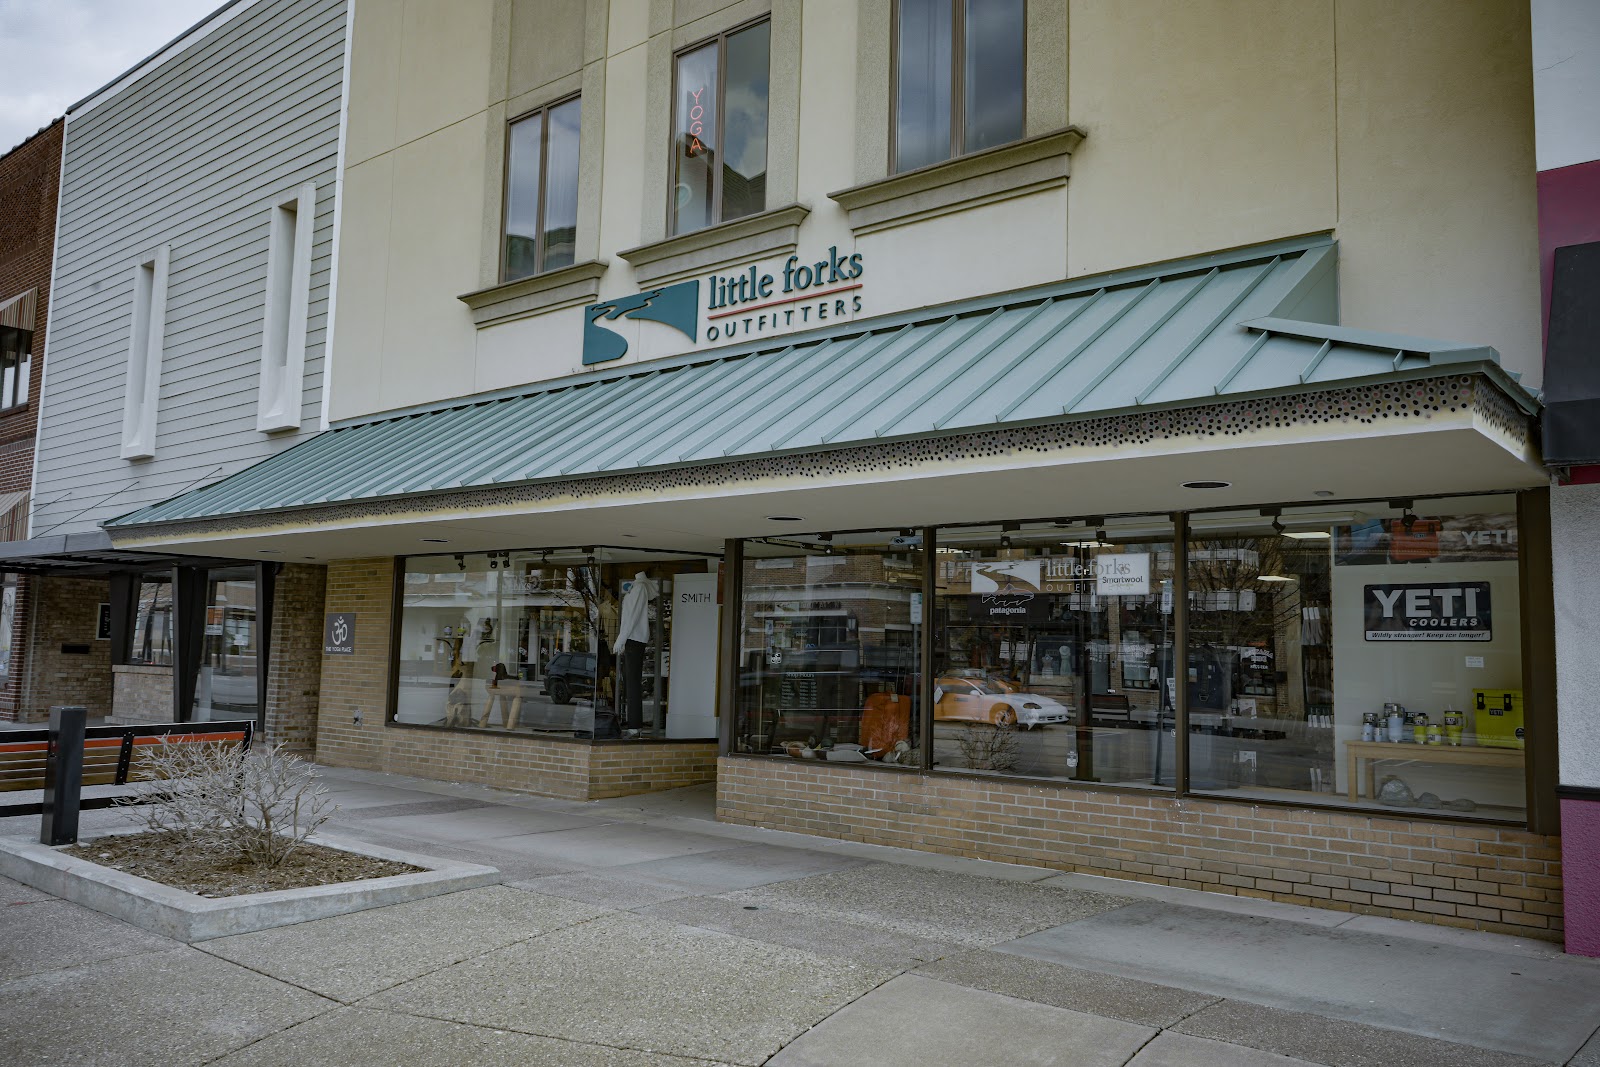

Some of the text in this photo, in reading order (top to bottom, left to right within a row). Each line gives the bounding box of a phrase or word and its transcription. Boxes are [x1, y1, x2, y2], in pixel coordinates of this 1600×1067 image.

[689, 87, 704, 154] YOGA
[708, 246, 863, 310] little forks
[706, 295, 863, 341] OUTFITTERS
[1462, 530, 1513, 545] YETI
[1046, 558, 1131, 577] little forks
[1102, 575, 1144, 584] Smartwool
[681, 593, 711, 603] SMITH
[1372, 587, 1478, 618] YETI
[989, 606, 1026, 615] patagonia
[1409, 618, 1478, 627] COOLERS
